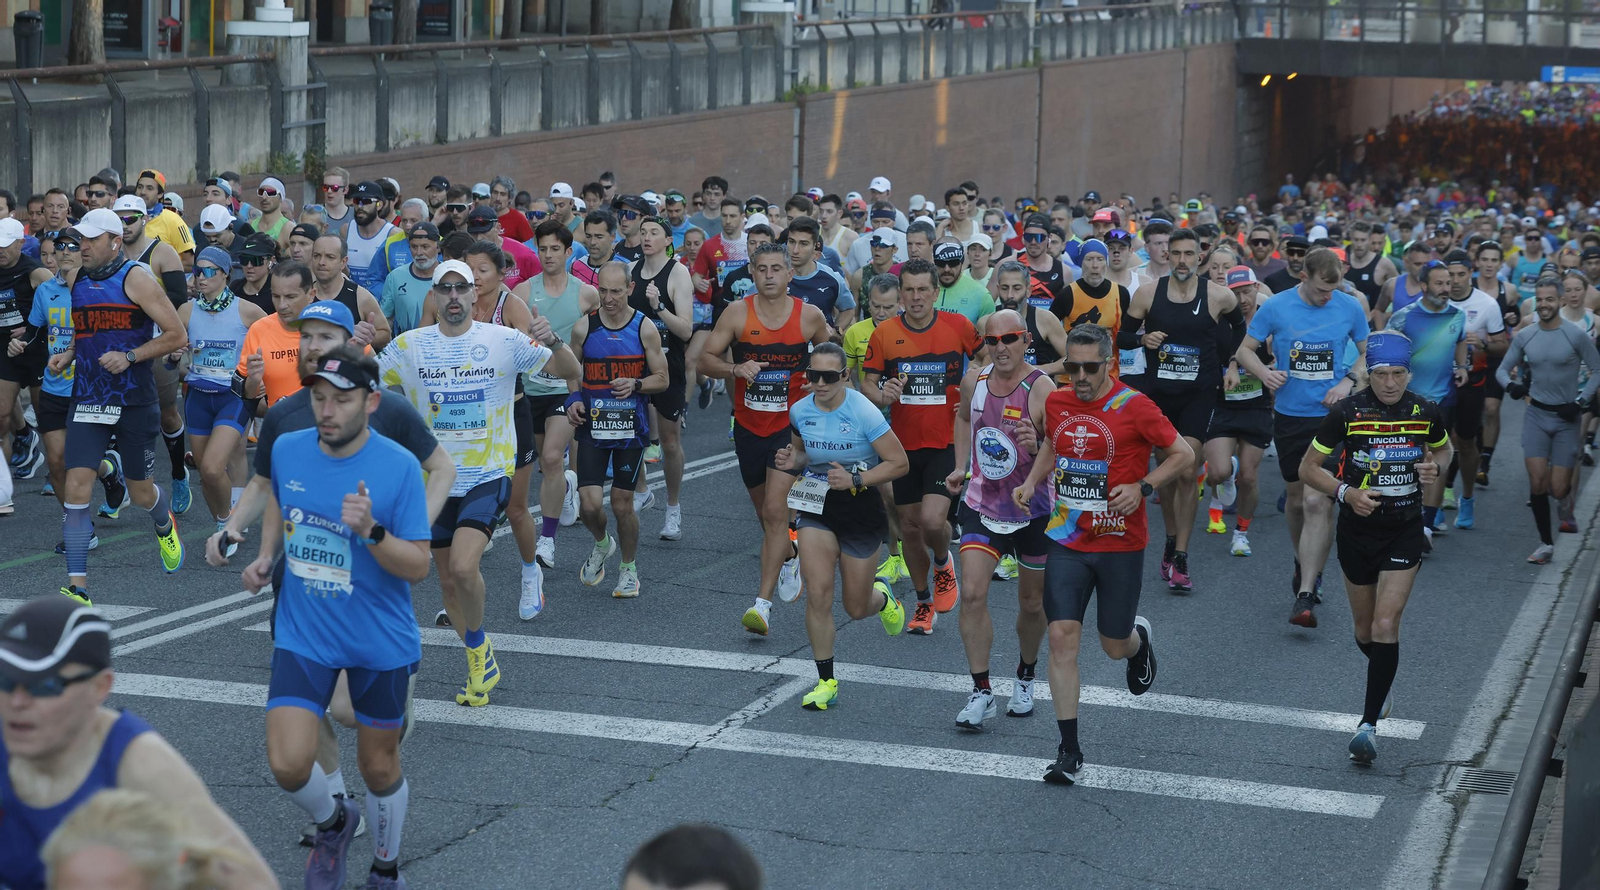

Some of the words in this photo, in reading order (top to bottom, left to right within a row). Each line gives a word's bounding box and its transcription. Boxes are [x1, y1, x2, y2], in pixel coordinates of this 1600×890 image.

[303, 304, 332, 316] HOKA
[270, 350, 286, 360] TOP
[760, 352, 802, 362] CUNETAS
[203, 358, 225, 368] LUCÍA
[1295, 361, 1328, 371] GASTON
[418, 368, 446, 379] Falcón
[451, 366, 494, 378] Training
[451, 377, 490, 385] Rendimiento
[911, 386, 934, 394] YUHU
[447, 393, 478, 402] ZURICH
[744, 392, 757, 401] LOLA
[765, 394, 788, 402] ÁLVARO
[76, 404, 103, 413] MIGUEL
[104, 406, 122, 414] ANG
[463, 420, 486, 428] T-M-D
[592, 420, 634, 429] BALTASAR
[804, 439, 852, 451] LMUÑÉCAR
[1071, 462, 1100, 470] ZURICH
[1071, 477, 1087, 485] 3943
[1378, 473, 1414, 485] ESKOYU
[789, 489, 804, 499] TANIA
[1059, 484, 1102, 499] MARCIAL
[307, 515, 344, 534] ZURICH
[1092, 517, 1125, 528] NING
[306, 534, 328, 546] 6792
[288, 544, 344, 567] ALBERTO
